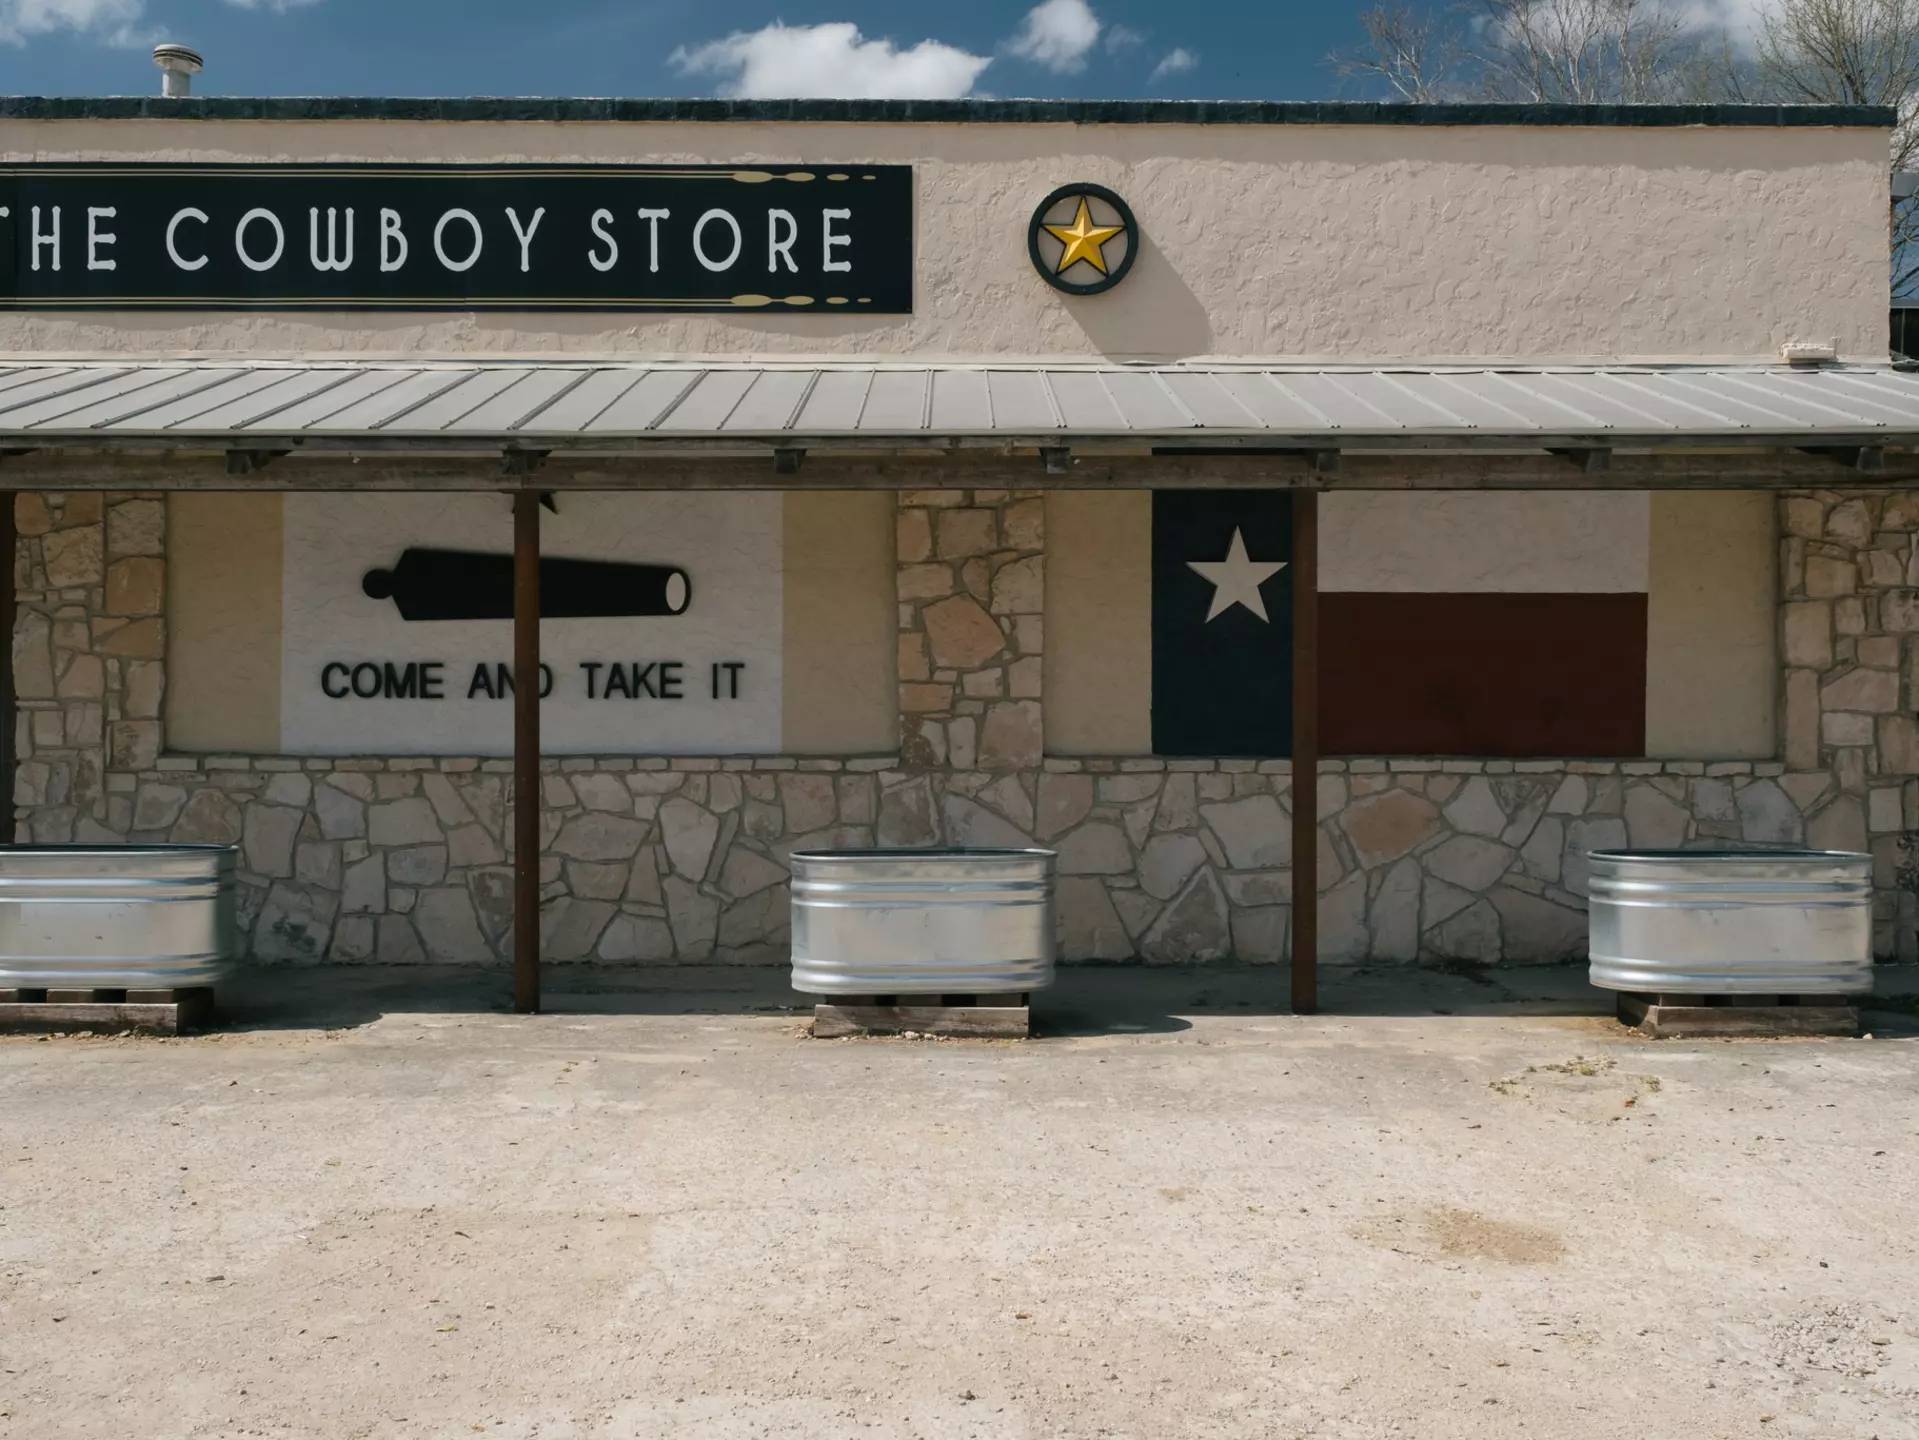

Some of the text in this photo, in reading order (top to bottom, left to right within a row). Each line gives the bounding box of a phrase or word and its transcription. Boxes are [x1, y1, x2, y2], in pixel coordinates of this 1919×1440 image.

[0, 205, 852, 274] HE COWBOY STORE
[321, 661, 445, 699] COME
[579, 661, 684, 699] TAKE
[711, 662, 746, 699] IT
